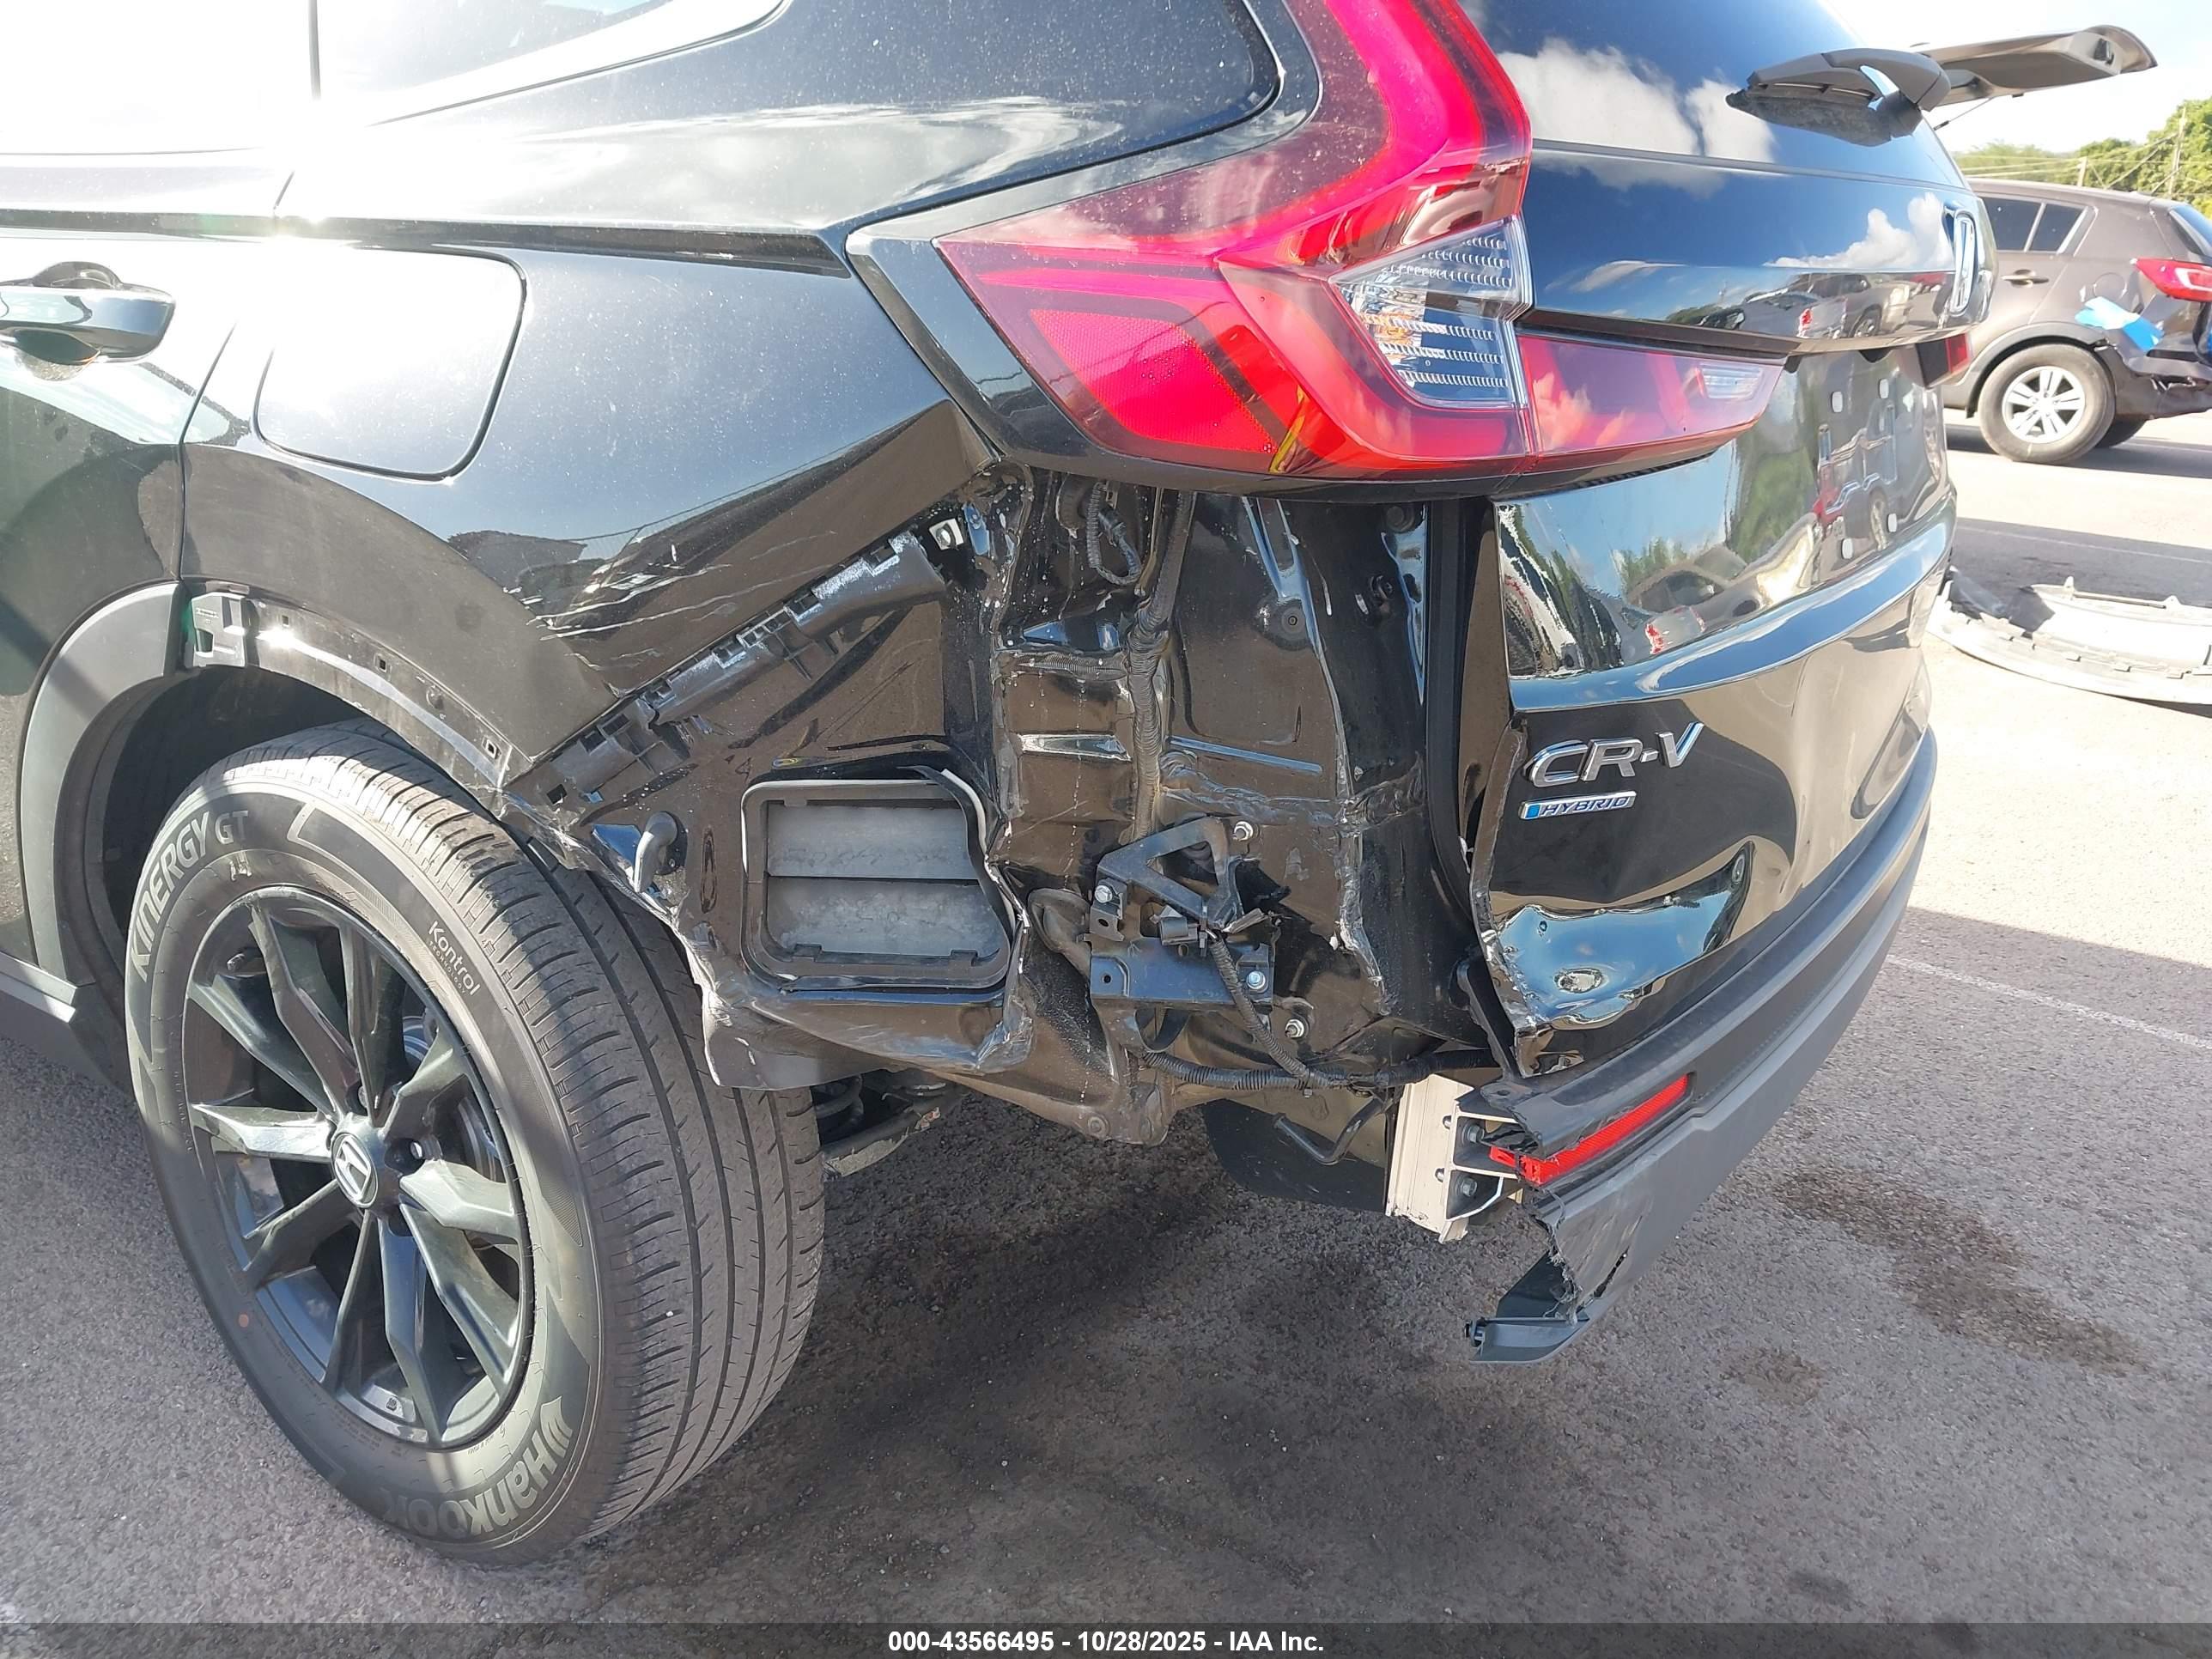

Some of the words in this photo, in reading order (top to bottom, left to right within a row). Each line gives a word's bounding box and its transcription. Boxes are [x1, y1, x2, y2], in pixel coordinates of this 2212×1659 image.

[1523, 722, 1705, 788] CR-V
[1542, 795, 1631, 816] HYBRID
[131, 811, 210, 983] KINERGY
[214, 810, 249, 846] GT
[428, 920, 481, 996] Kontrol
